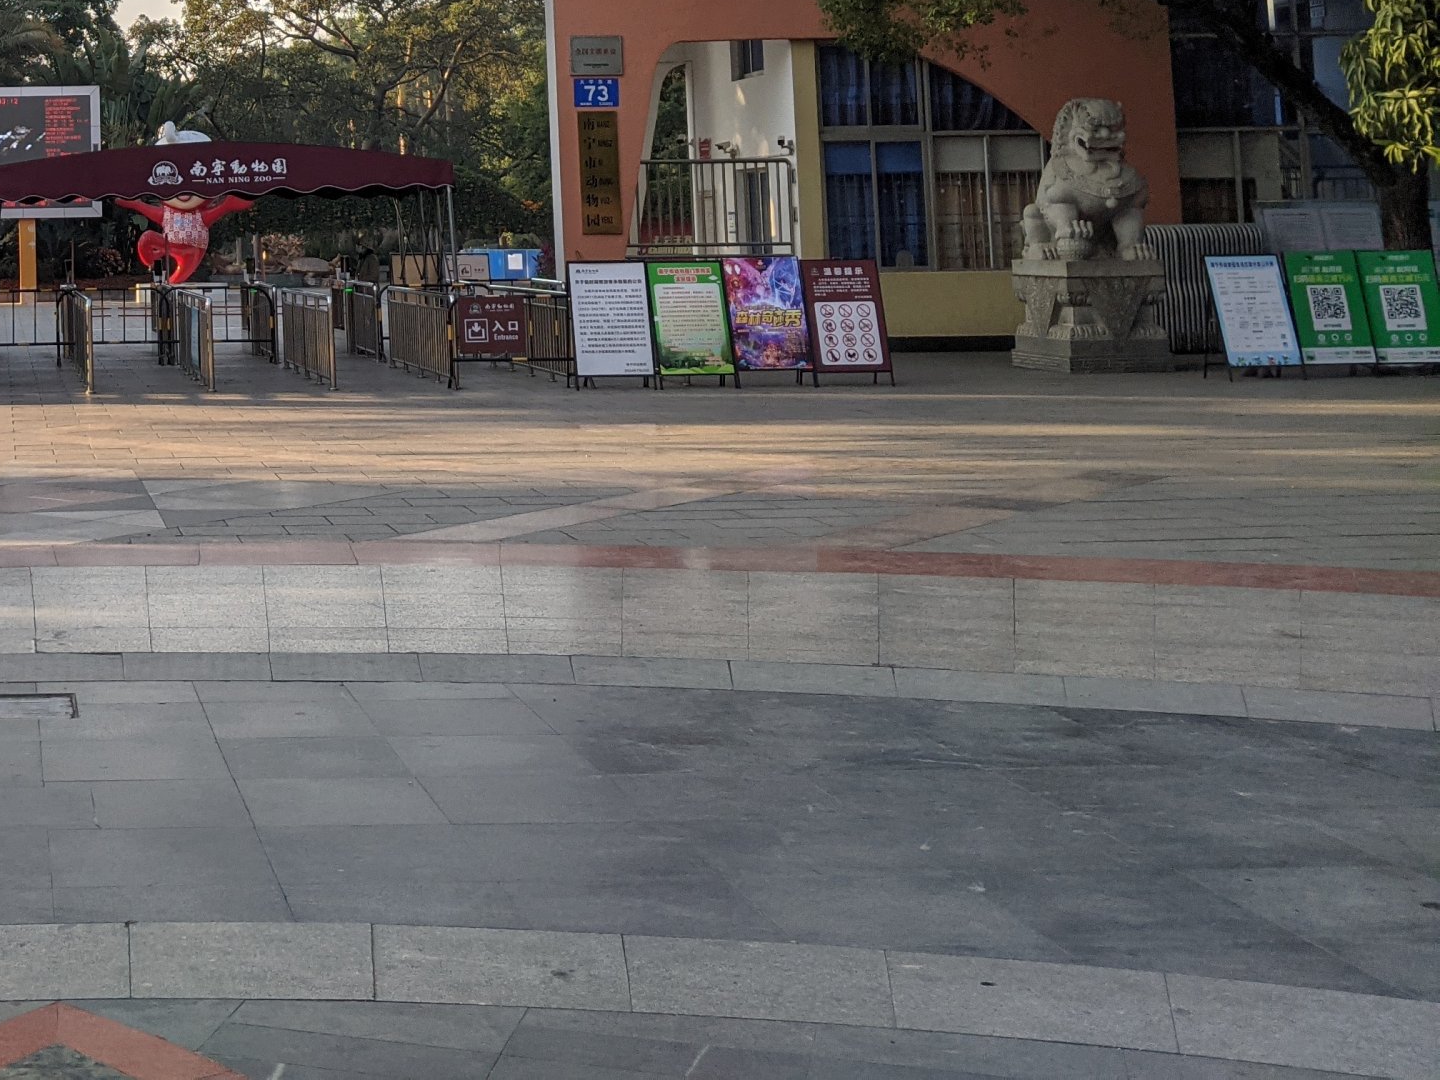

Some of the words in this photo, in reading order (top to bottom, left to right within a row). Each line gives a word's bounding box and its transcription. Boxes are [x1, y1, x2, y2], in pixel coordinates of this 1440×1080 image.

[583, 85, 609, 101] 73
[492, 320, 519, 332] 入口
[494, 333, 519, 341] Entrance
